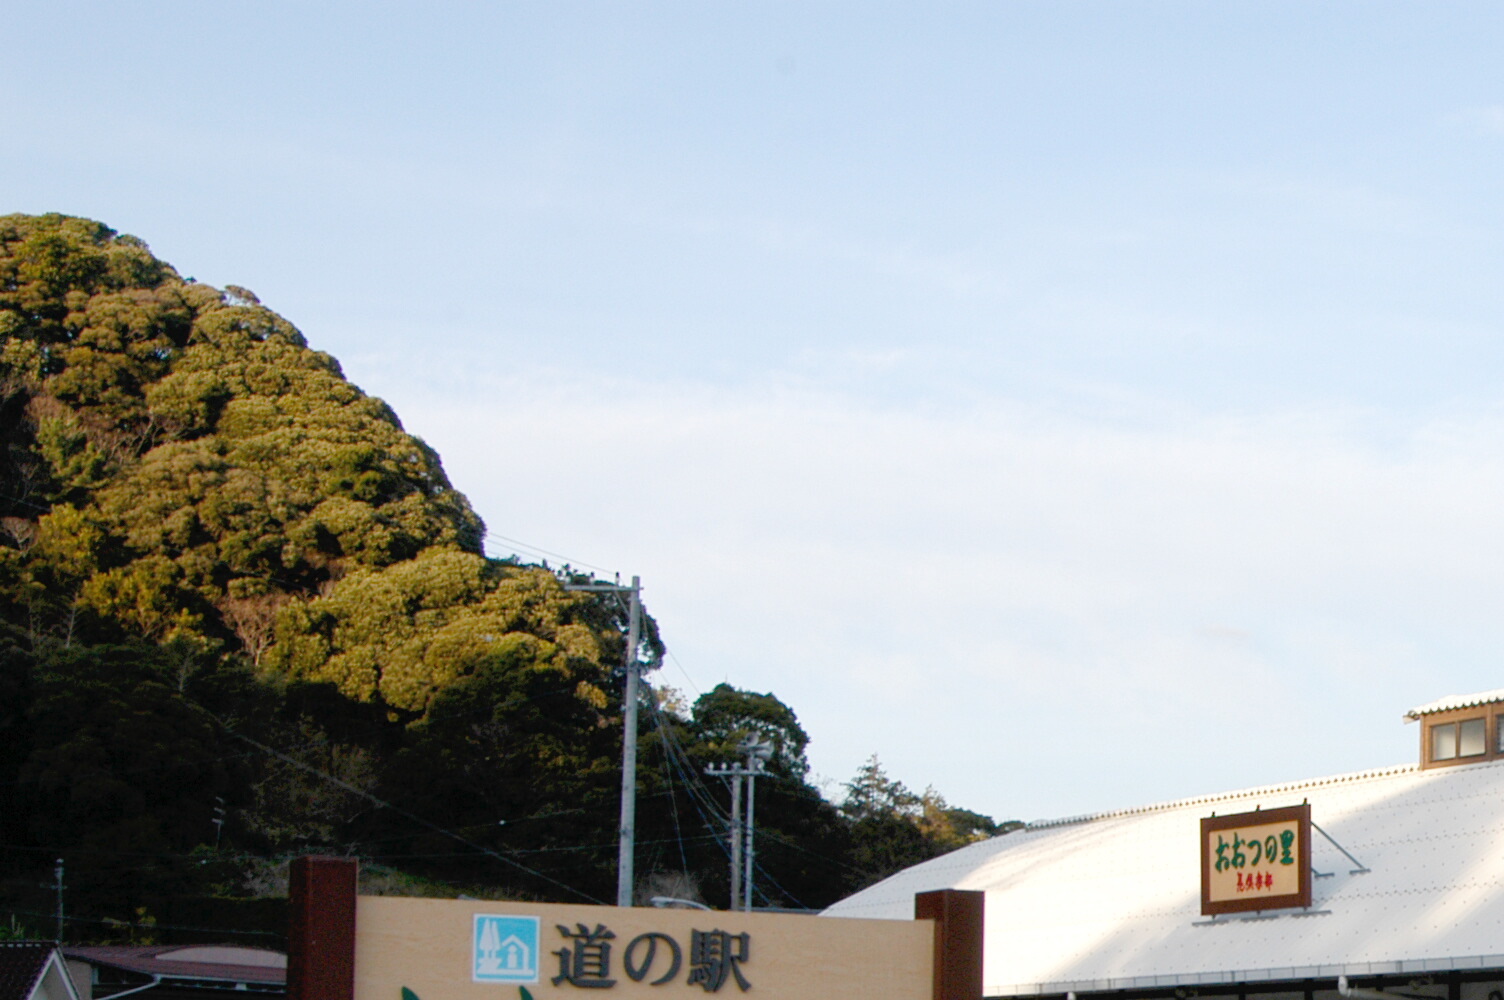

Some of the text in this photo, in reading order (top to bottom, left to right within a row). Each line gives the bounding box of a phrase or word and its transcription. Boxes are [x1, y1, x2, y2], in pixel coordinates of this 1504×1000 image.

[1215, 829, 1295, 873] おおつの里
[550, 922, 752, 993] 道の駅
